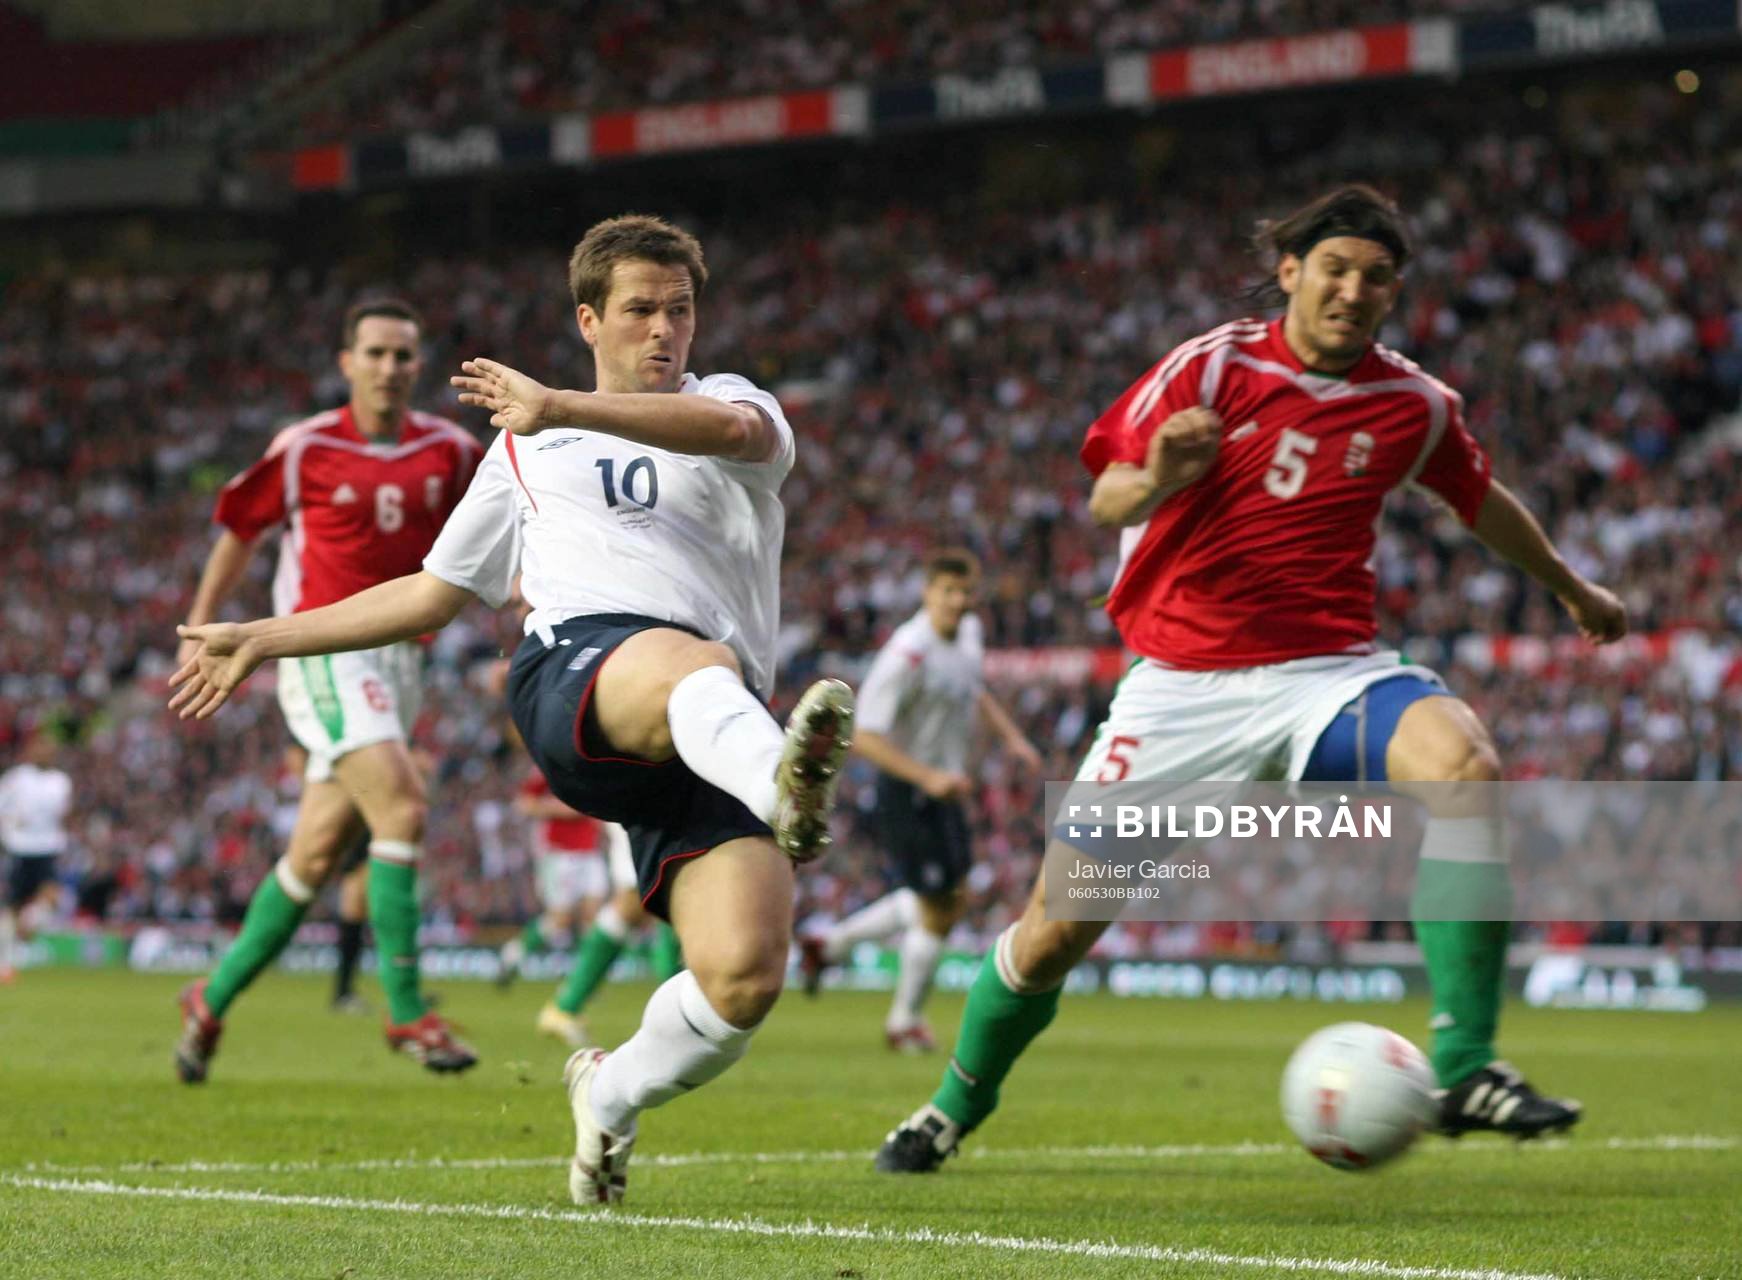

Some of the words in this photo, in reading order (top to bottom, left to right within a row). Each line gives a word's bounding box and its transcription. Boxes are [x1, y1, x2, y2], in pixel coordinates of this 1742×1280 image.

[1187, 32, 1366, 93] ENGLAND
[594, 455, 659, 510] 10
[1262, 427, 1318, 500] 5
[373, 483, 405, 533] 6
[1096, 735, 1142, 787] 5
